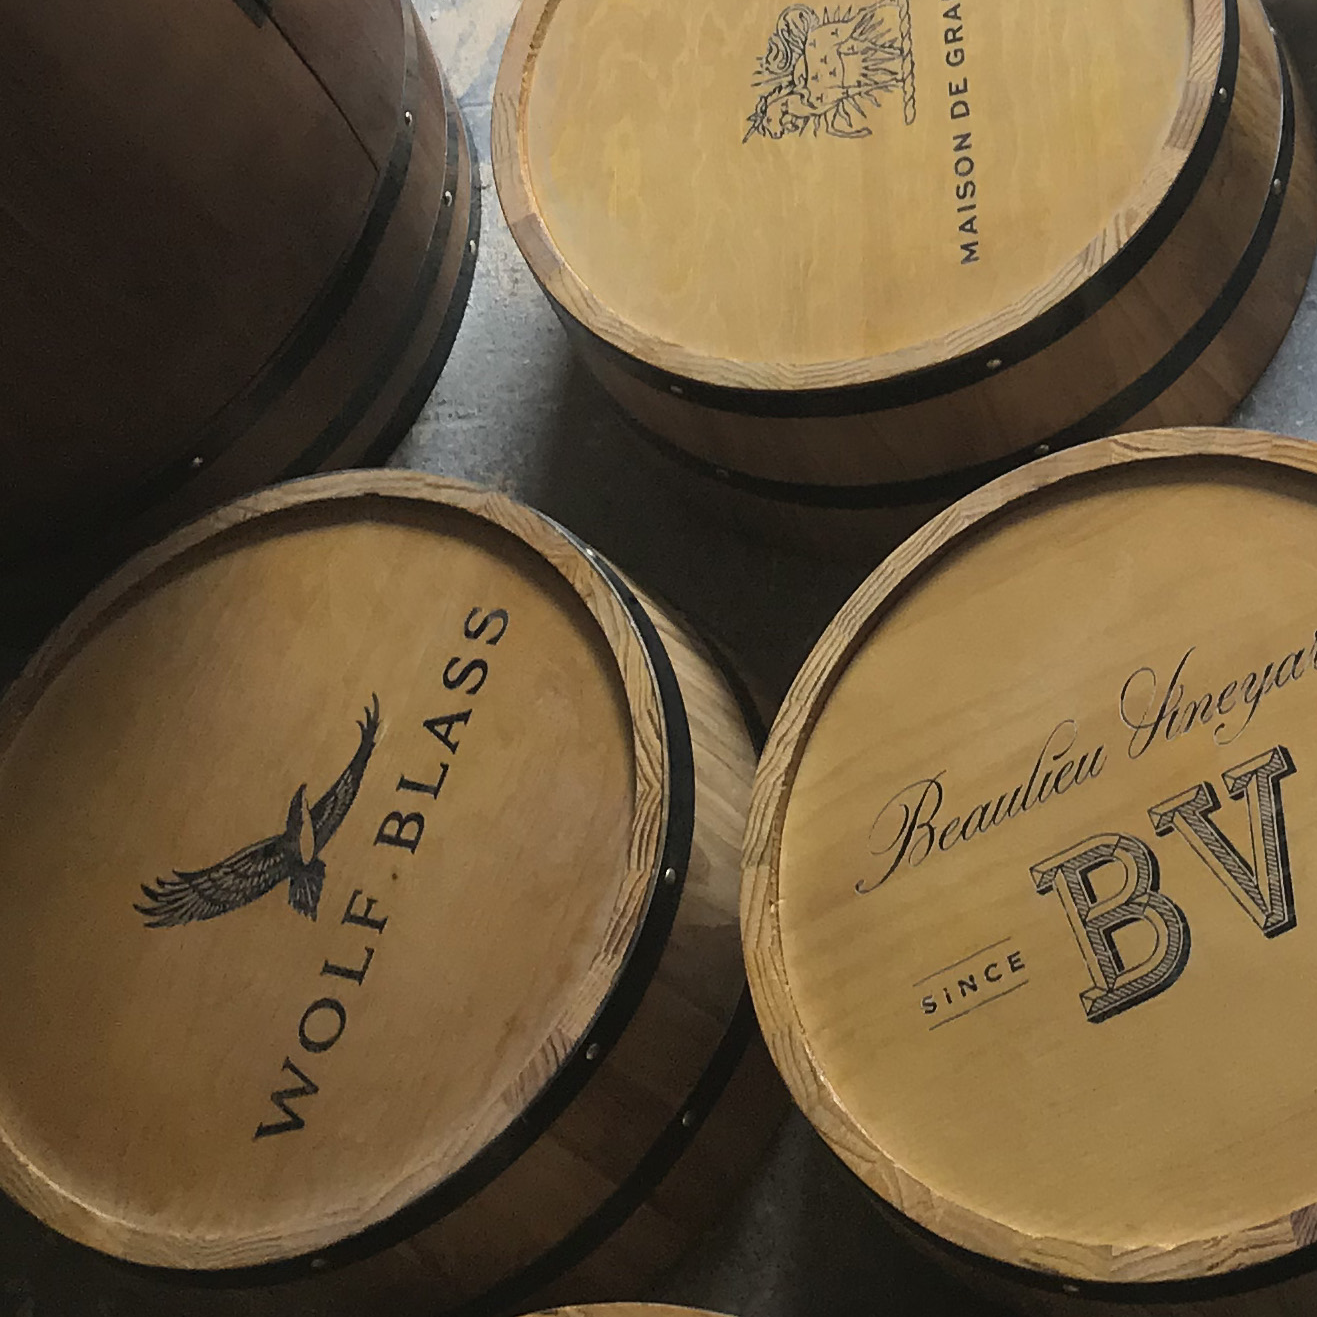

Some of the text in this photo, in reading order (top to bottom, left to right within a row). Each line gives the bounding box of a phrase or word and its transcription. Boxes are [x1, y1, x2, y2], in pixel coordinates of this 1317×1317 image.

[948, 77, 972, 121] DE
[952, 132, 981, 266] MAISON
[253, 605, 510, 1142] WOLF BLASS
[855, 718, 1108, 895] Beaulieu
[1028, 744, 1299, 1024] BV
[919, 949, 1027, 1016] SINCE
